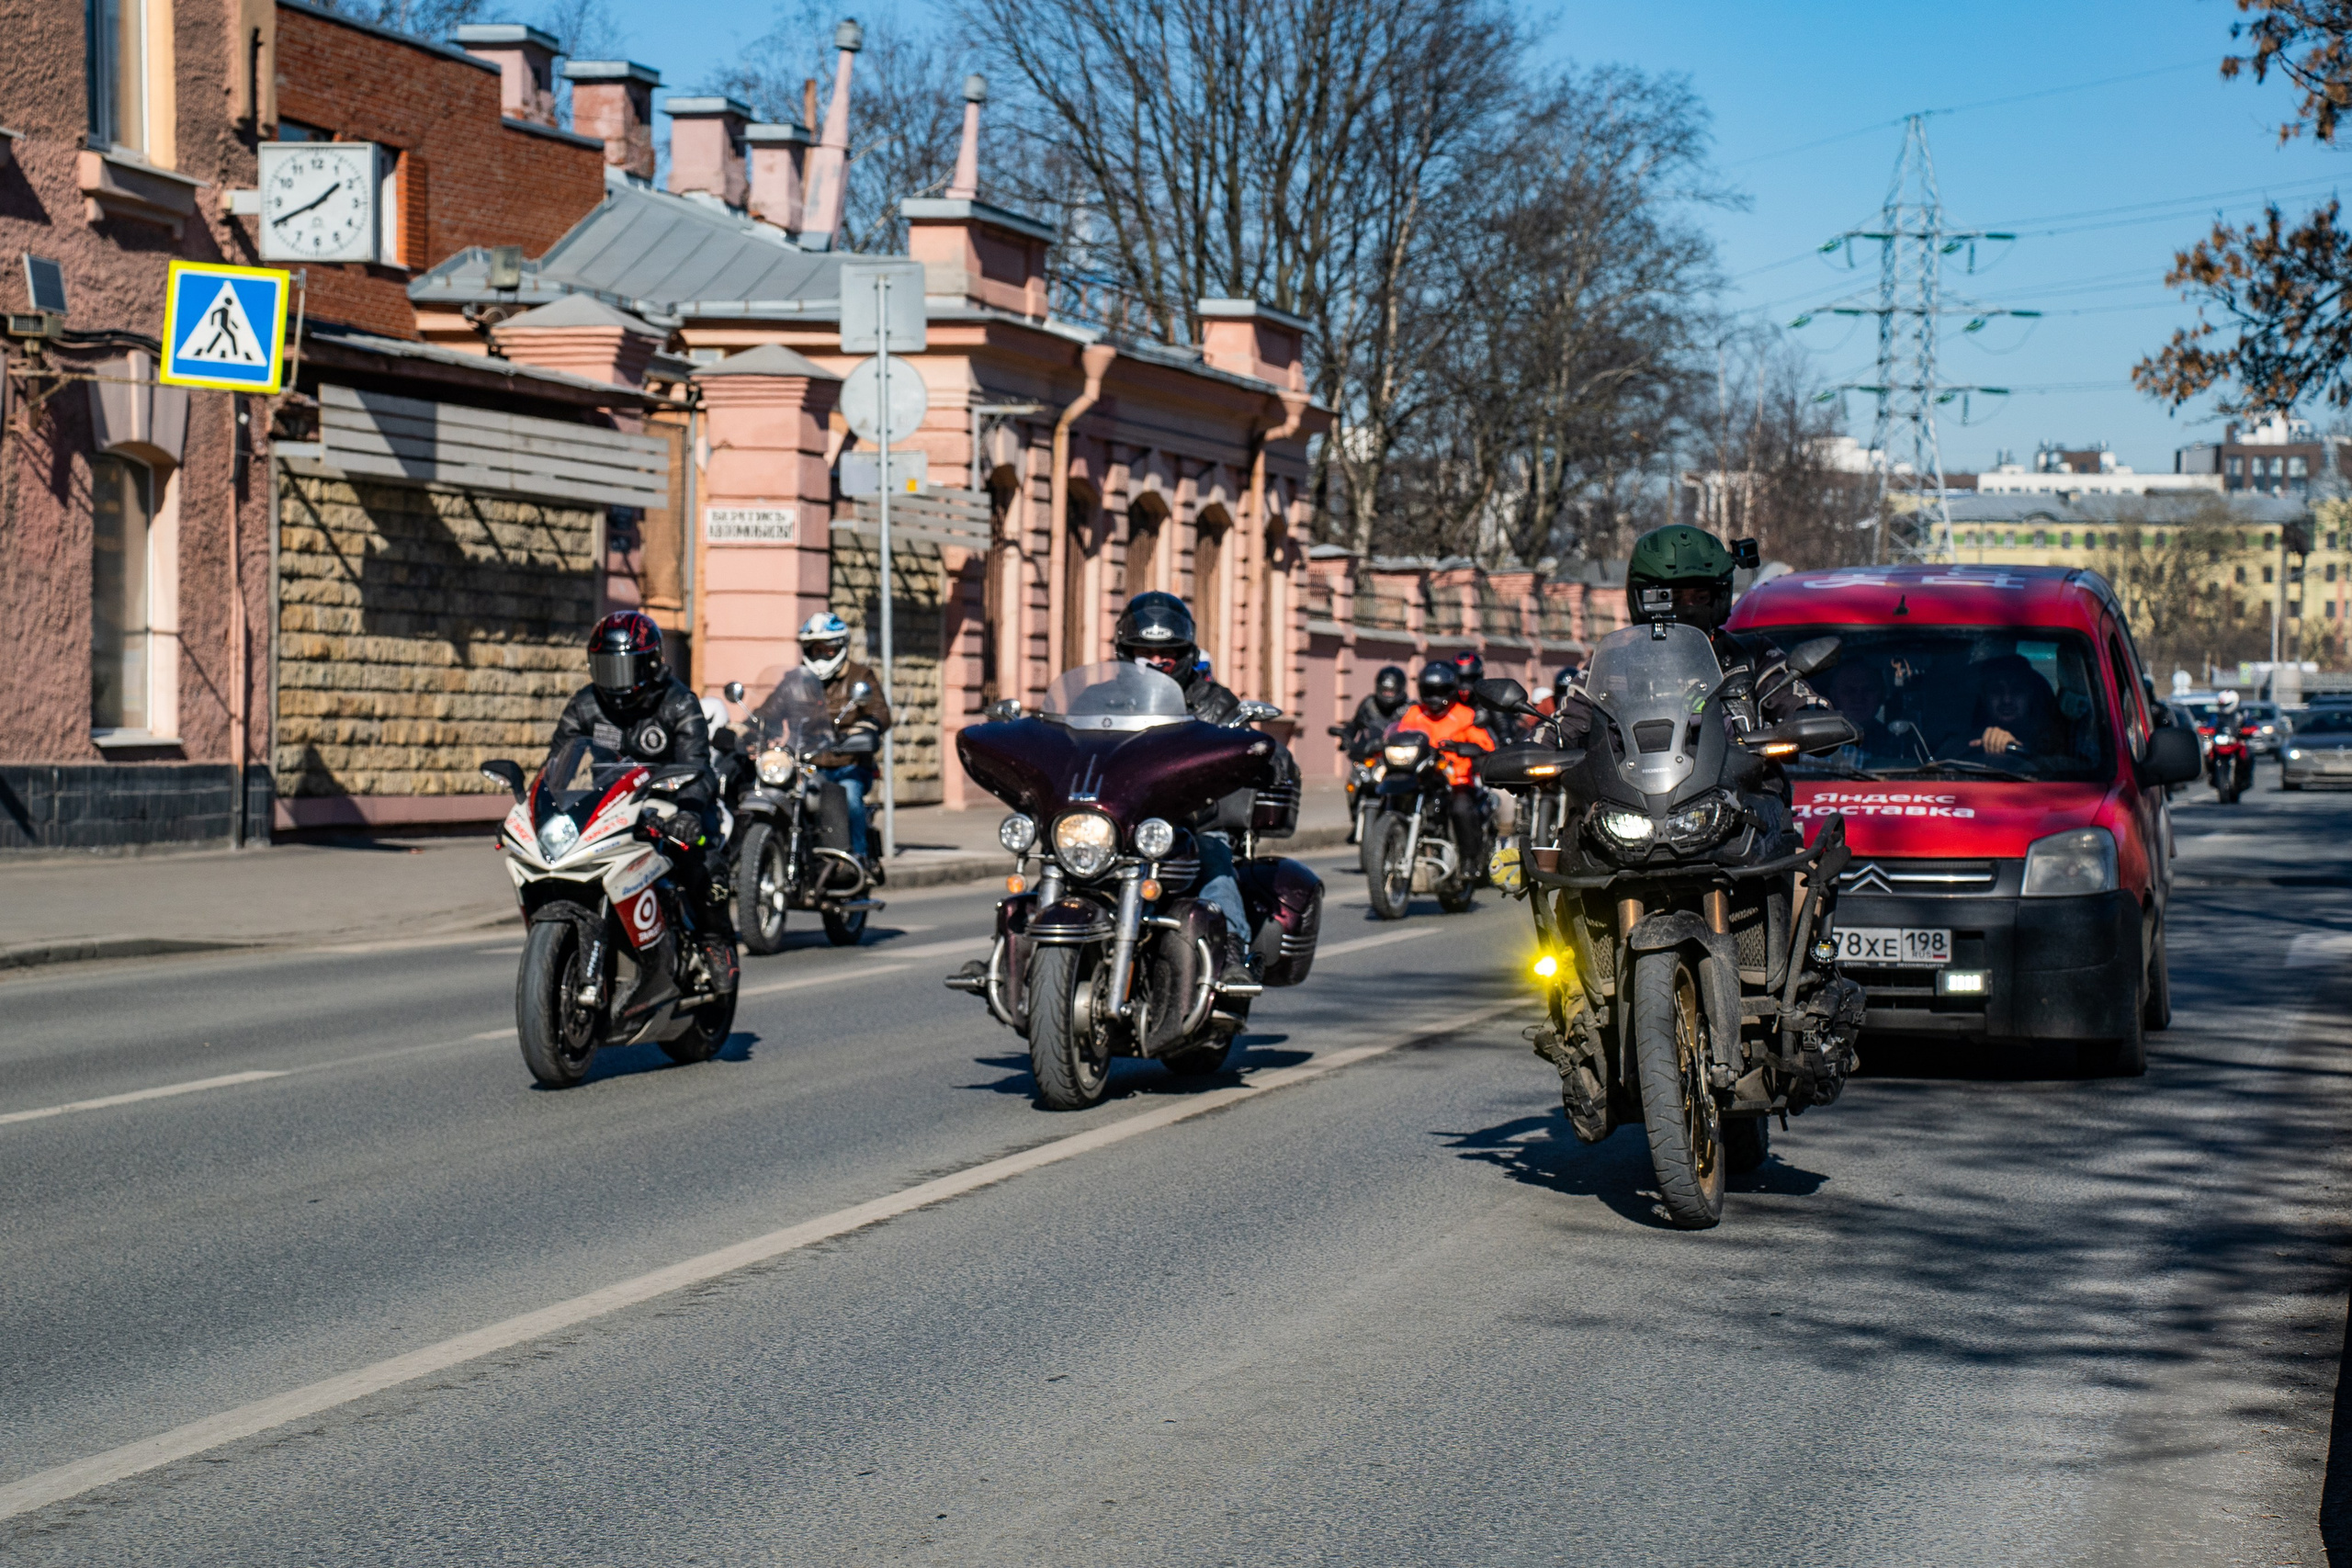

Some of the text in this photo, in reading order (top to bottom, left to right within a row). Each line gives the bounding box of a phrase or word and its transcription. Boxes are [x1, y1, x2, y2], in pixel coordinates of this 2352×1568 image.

[311, 159, 323, 169] 12
[292, 165, 303, 175] 11
[334, 165, 339, 175] 1
[280, 178, 293, 189] 10
[347, 179, 354, 190] 2
[276, 197, 282, 208] 9
[353, 197, 360, 209] 3
[346, 218, 353, 228] 4
[296, 231, 302, 241] 7
[314, 236, 321, 246] 6
[334, 232, 340, 242] 5
[1813, 793, 1956, 804] Яндекс
[1792, 805, 1974, 818] Доставка
[1905, 932, 1944, 951] 198
[1912, 950, 1932, 959] RUS
